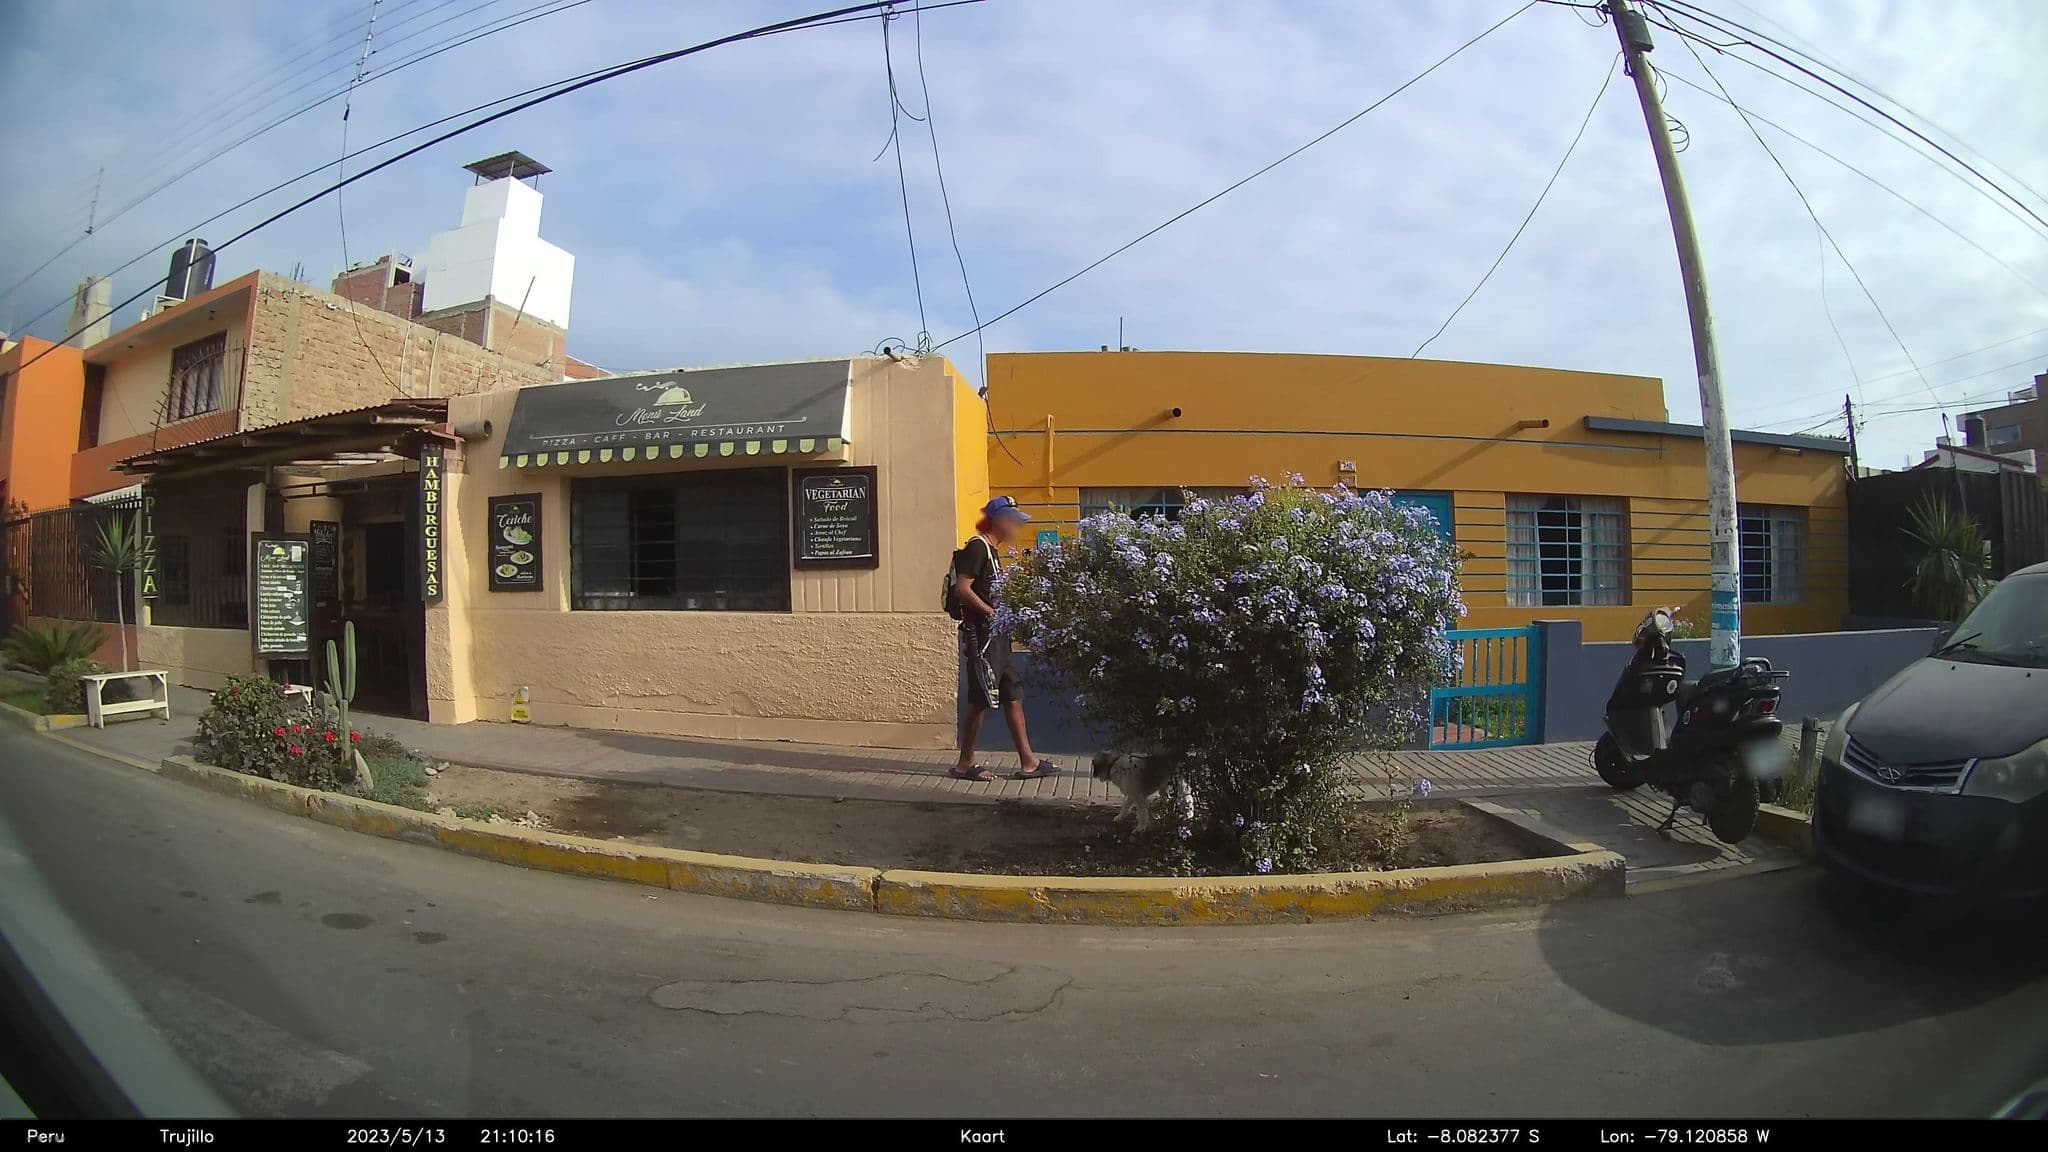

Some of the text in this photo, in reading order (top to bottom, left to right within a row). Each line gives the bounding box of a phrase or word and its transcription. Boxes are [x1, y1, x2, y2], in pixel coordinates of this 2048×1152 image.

[664, 403, 706, 422] Land
[543, 438, 576, 446] PIZZA
[645, 431, 670, 440] BAR
[692, 425, 785, 437] RESTAURANT
[805, 486, 866, 500] VEGETARIAN
[424, 456, 440, 596] HAMBURGUESAS
[144, 496, 158, 593] PIZZA
